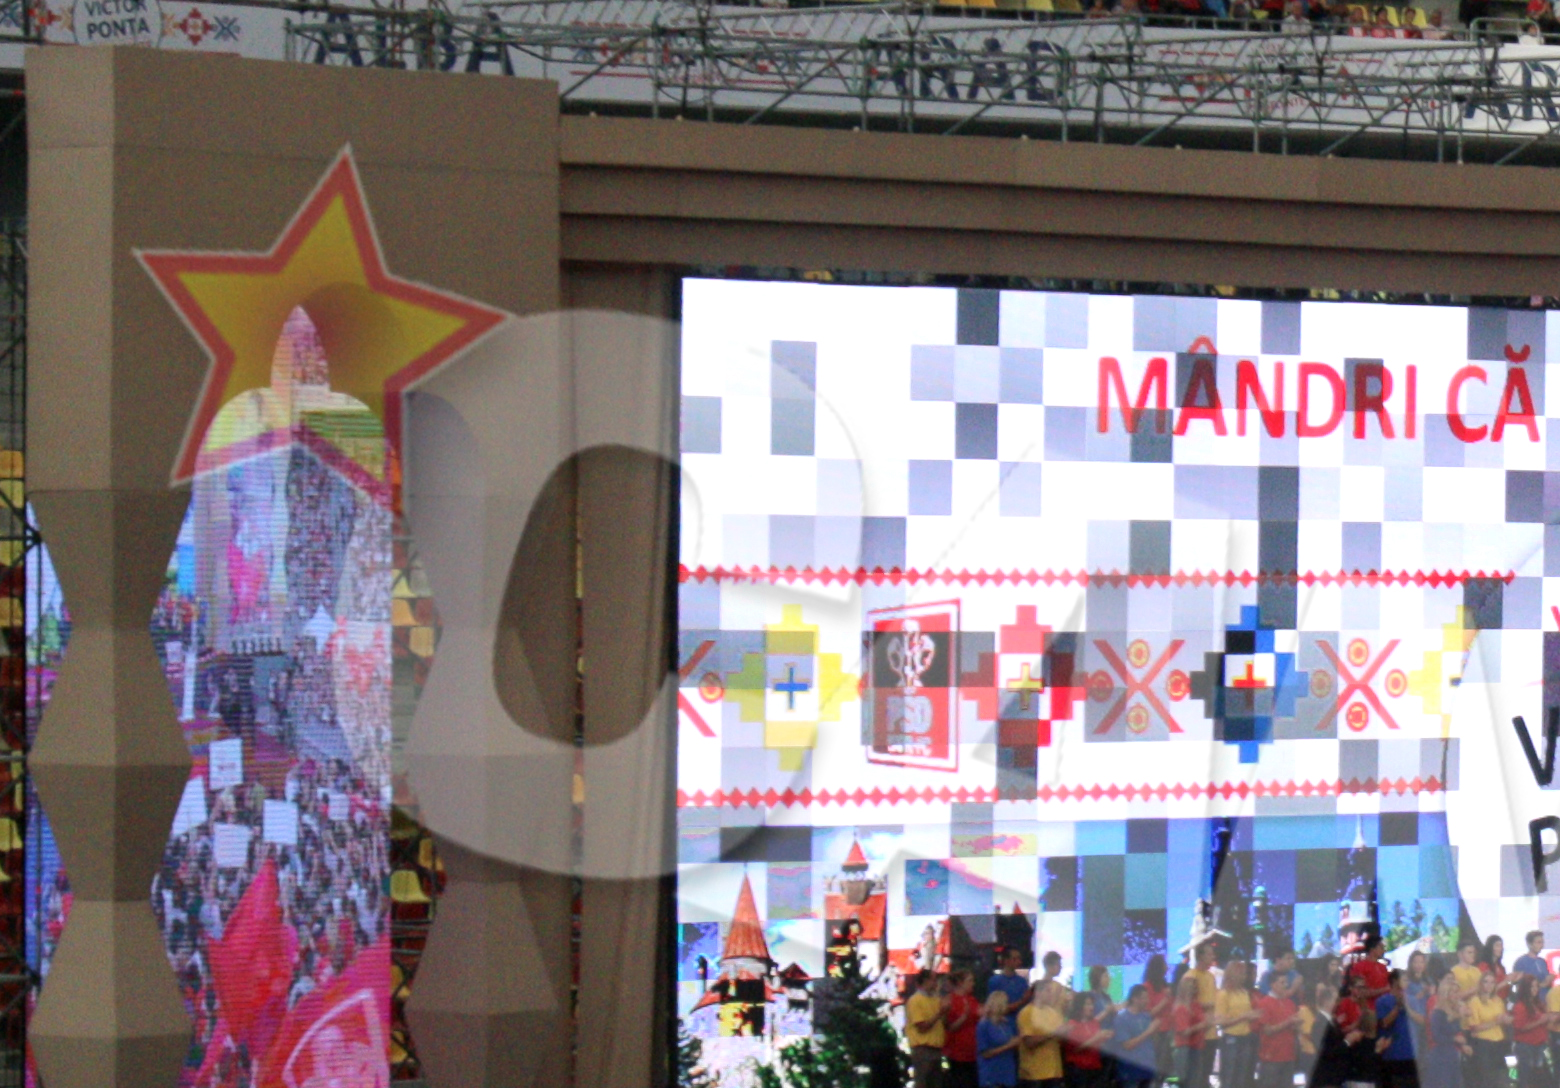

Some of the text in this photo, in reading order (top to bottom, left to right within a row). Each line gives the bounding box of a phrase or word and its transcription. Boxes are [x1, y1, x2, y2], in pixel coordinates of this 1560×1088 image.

[88, 17, 150, 39] PONTA
[1097, 336, 1417, 441] MÂNDRI
[1446, 343, 1540, 443] CĂ
